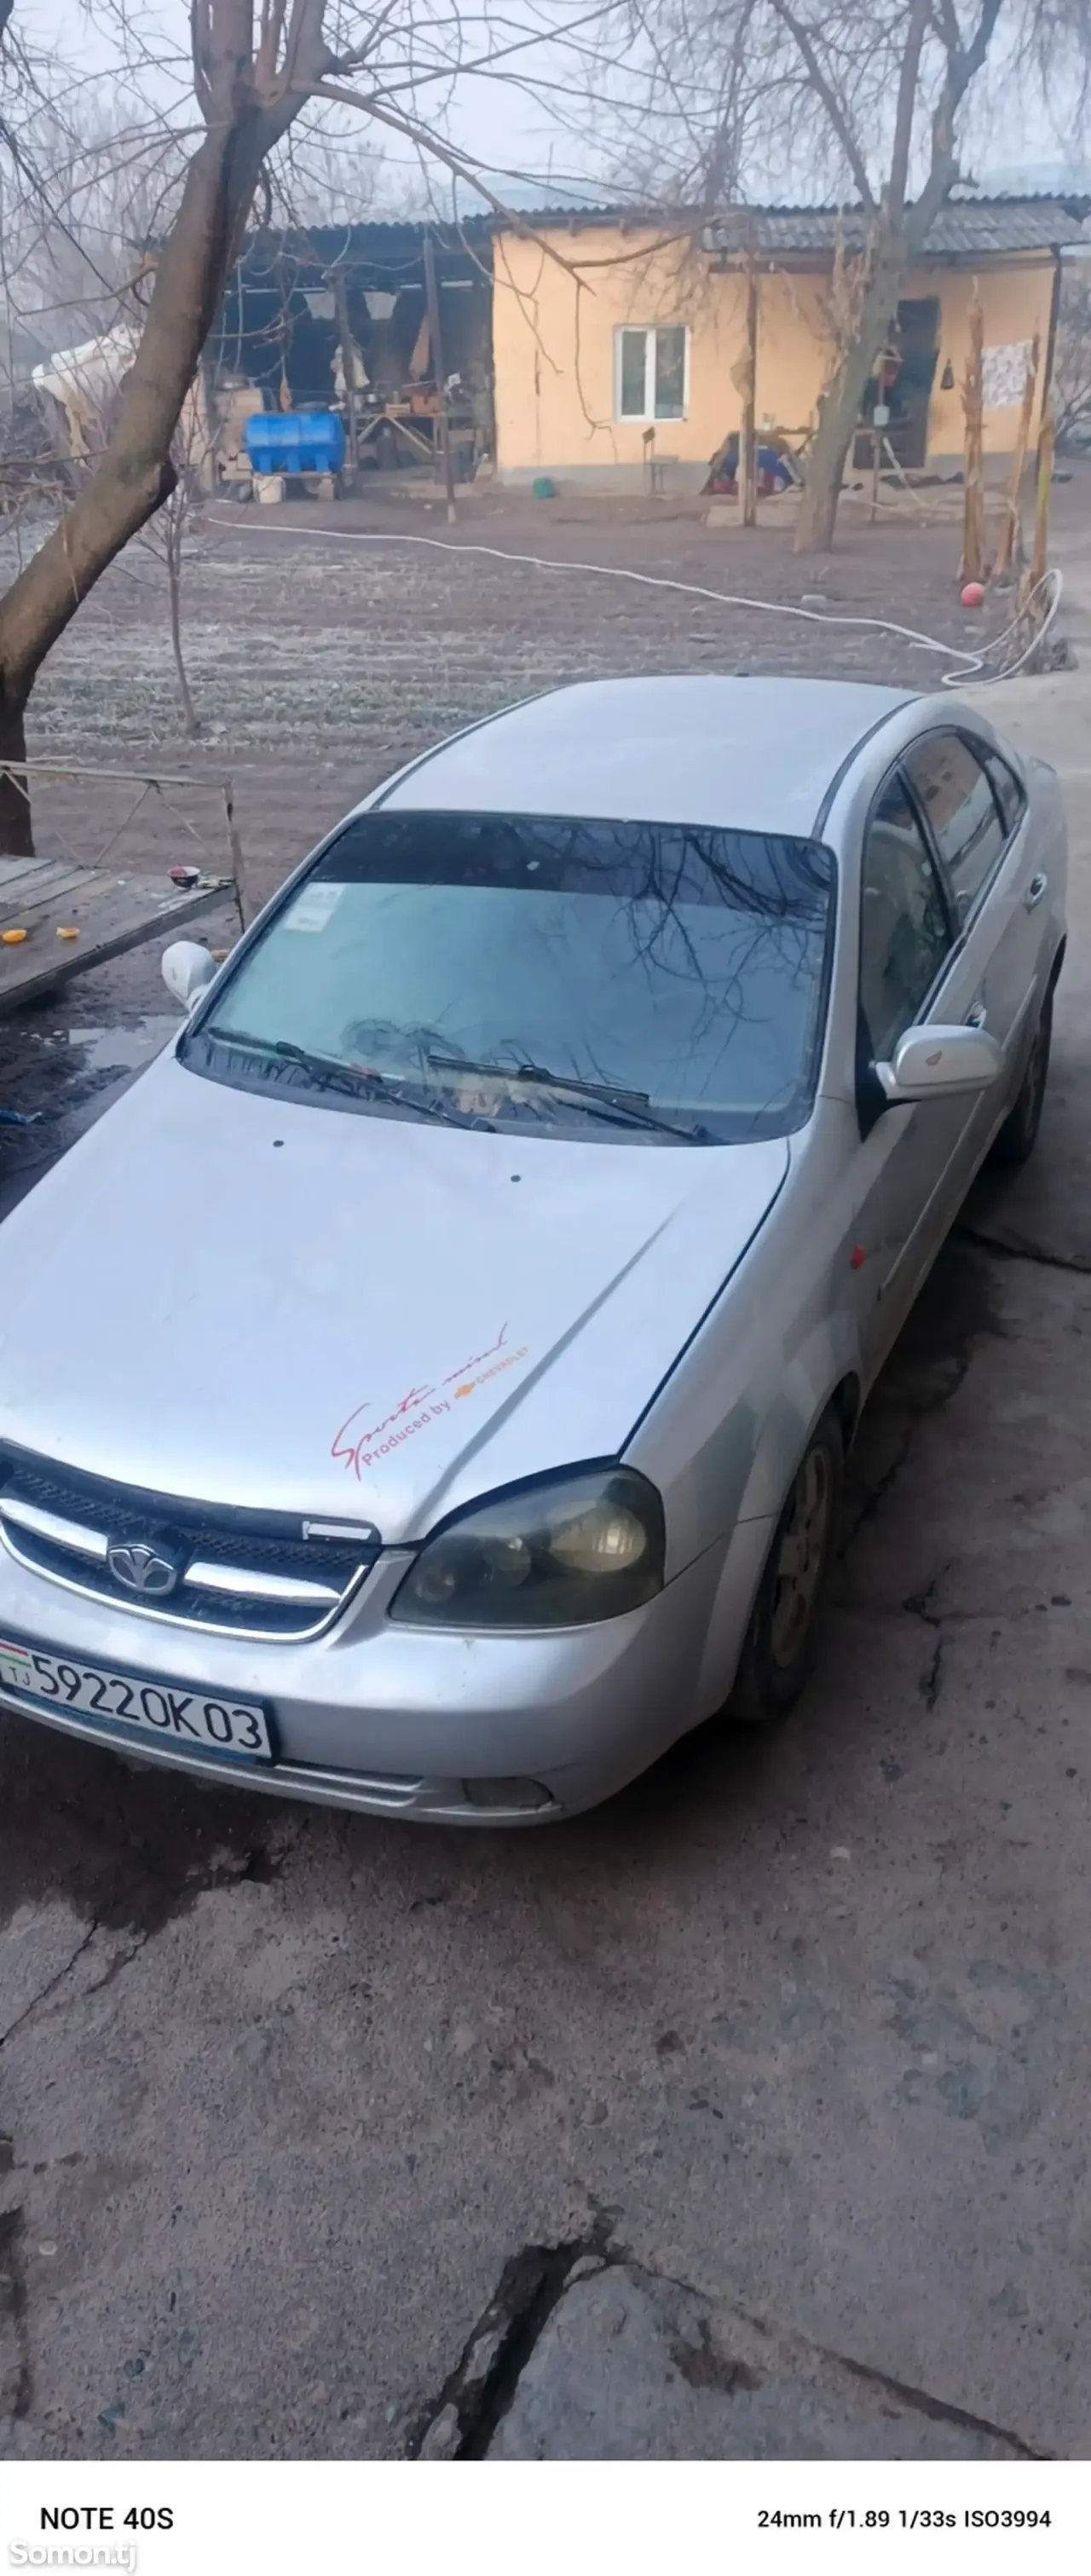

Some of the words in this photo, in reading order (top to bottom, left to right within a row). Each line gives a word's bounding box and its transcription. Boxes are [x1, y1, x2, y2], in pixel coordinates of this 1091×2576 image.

[361, 1412, 431, 1466] Produced
[429, 1399, 451, 1415] by
[9, 1666, 31, 1686] TJ
